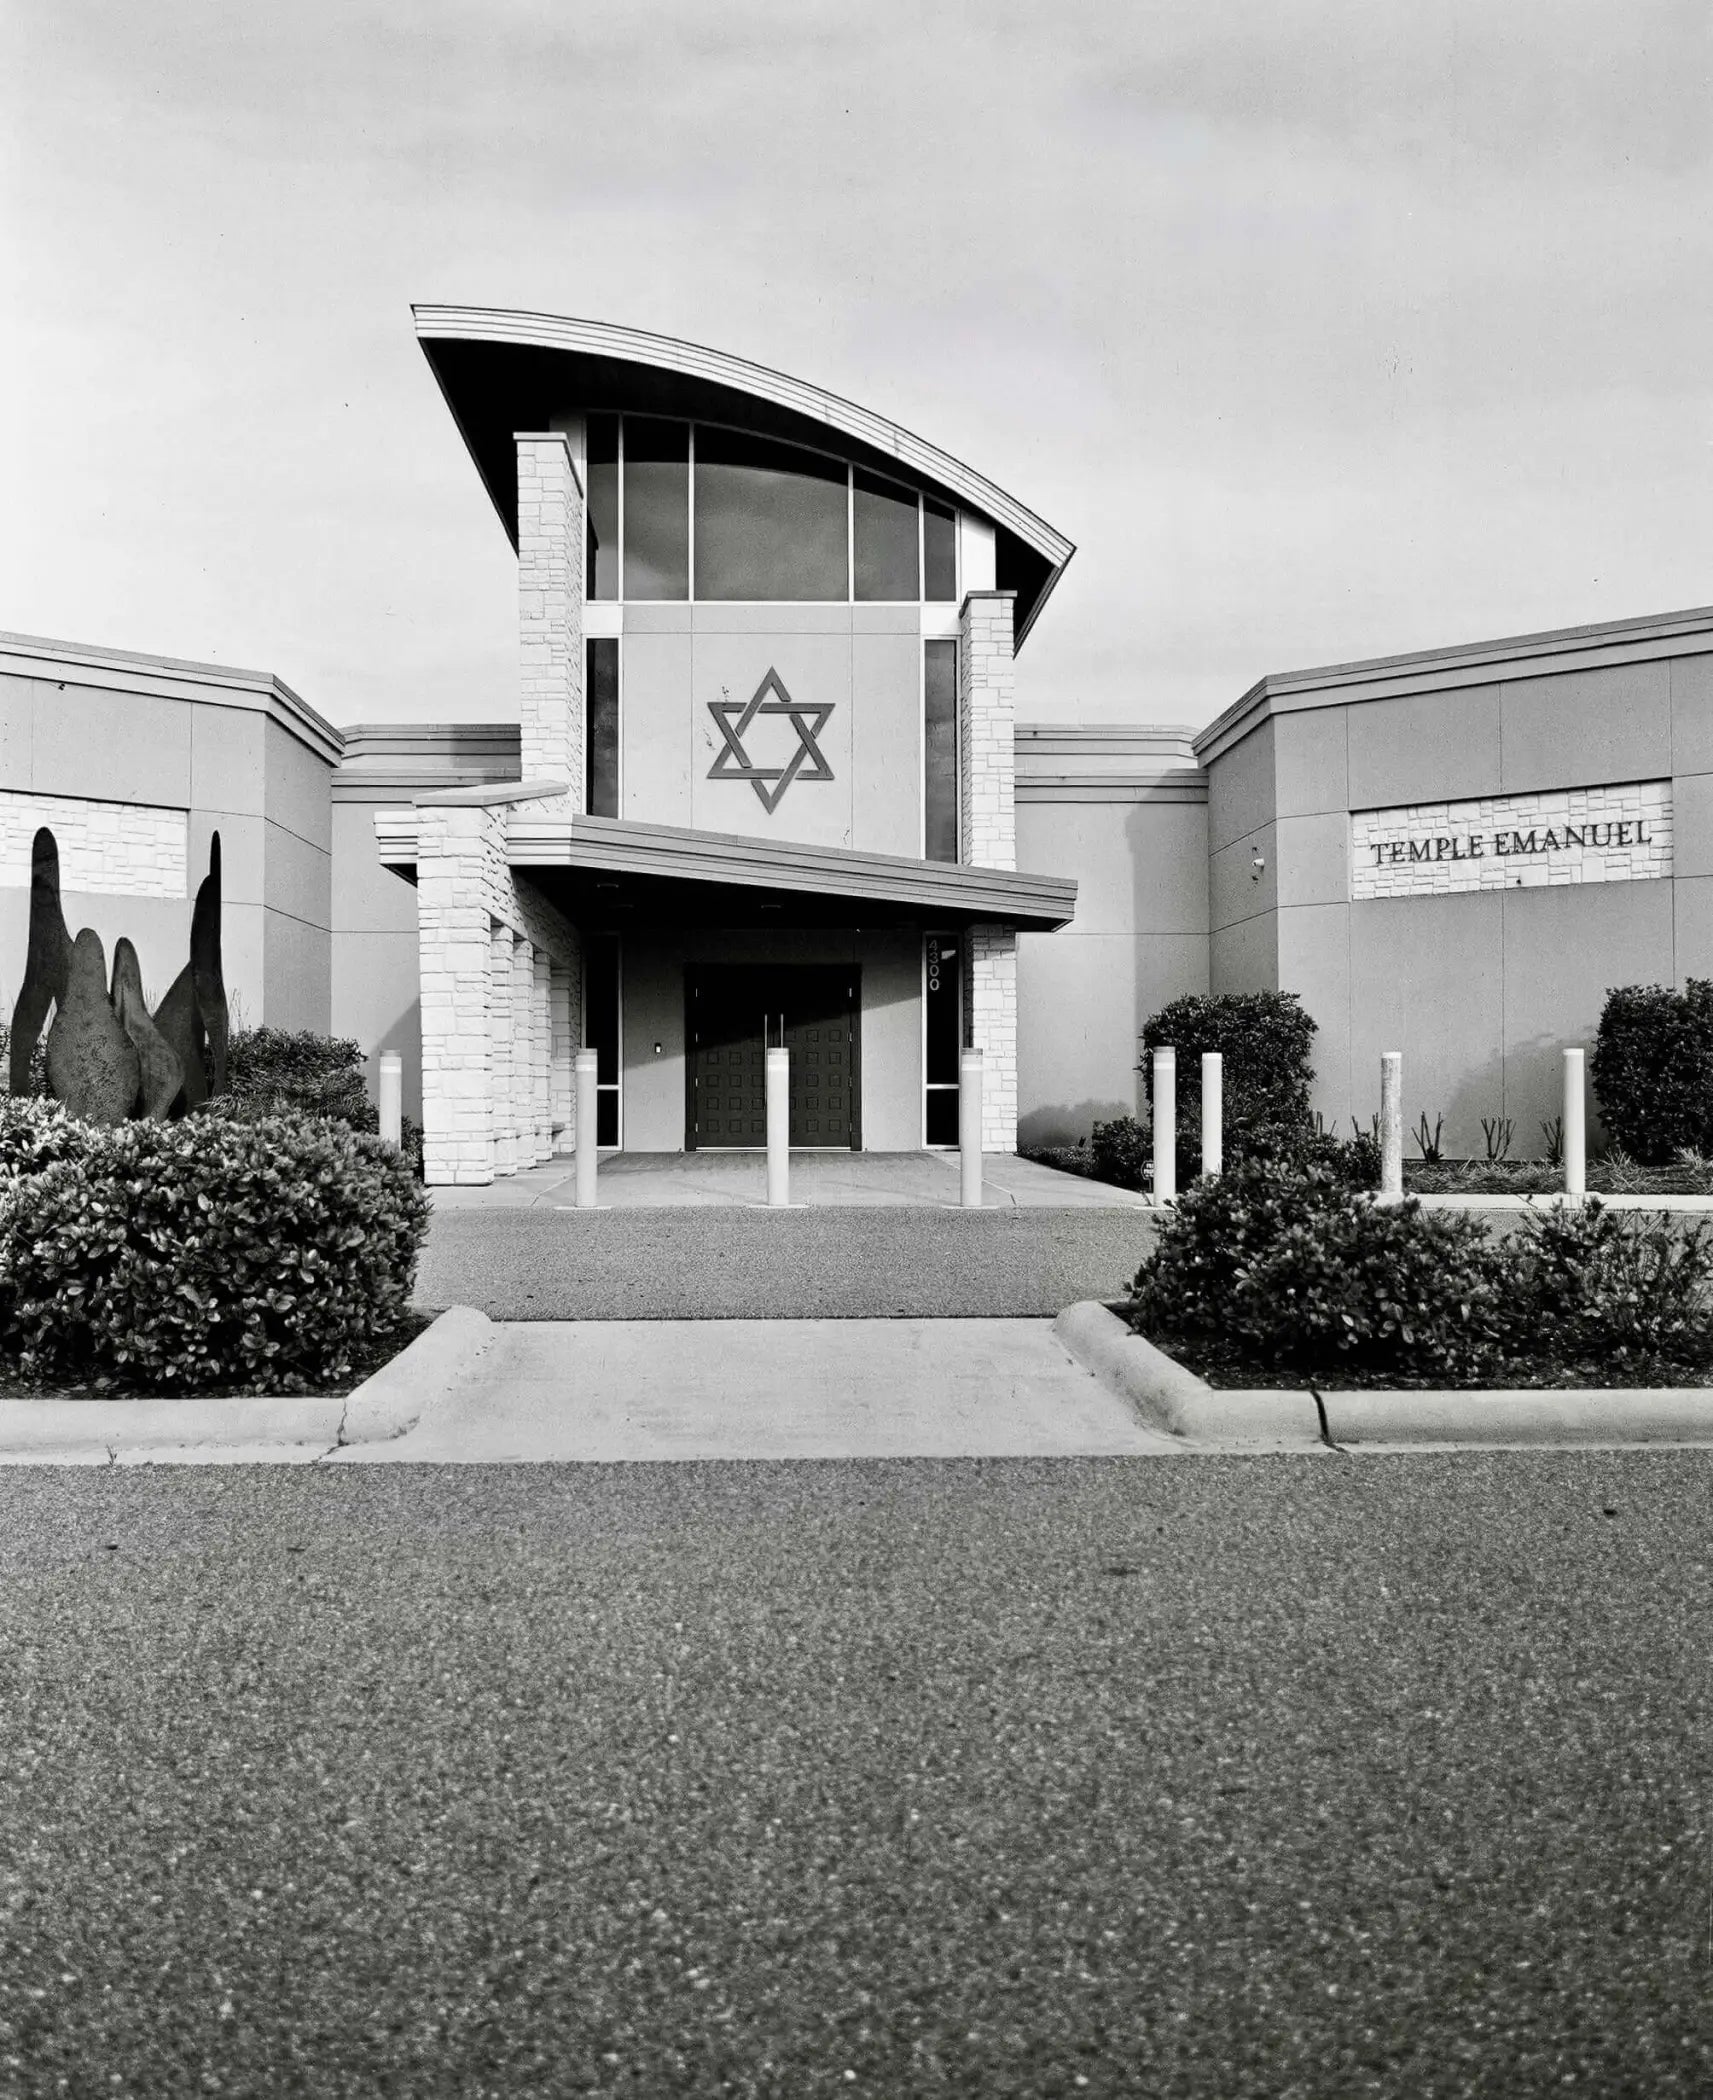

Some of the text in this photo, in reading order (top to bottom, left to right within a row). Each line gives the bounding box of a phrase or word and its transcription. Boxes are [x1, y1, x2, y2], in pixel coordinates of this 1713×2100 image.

[1370, 820, 1652, 864] TEMPLE EMANUEL
[928, 939, 940, 991] 4300
